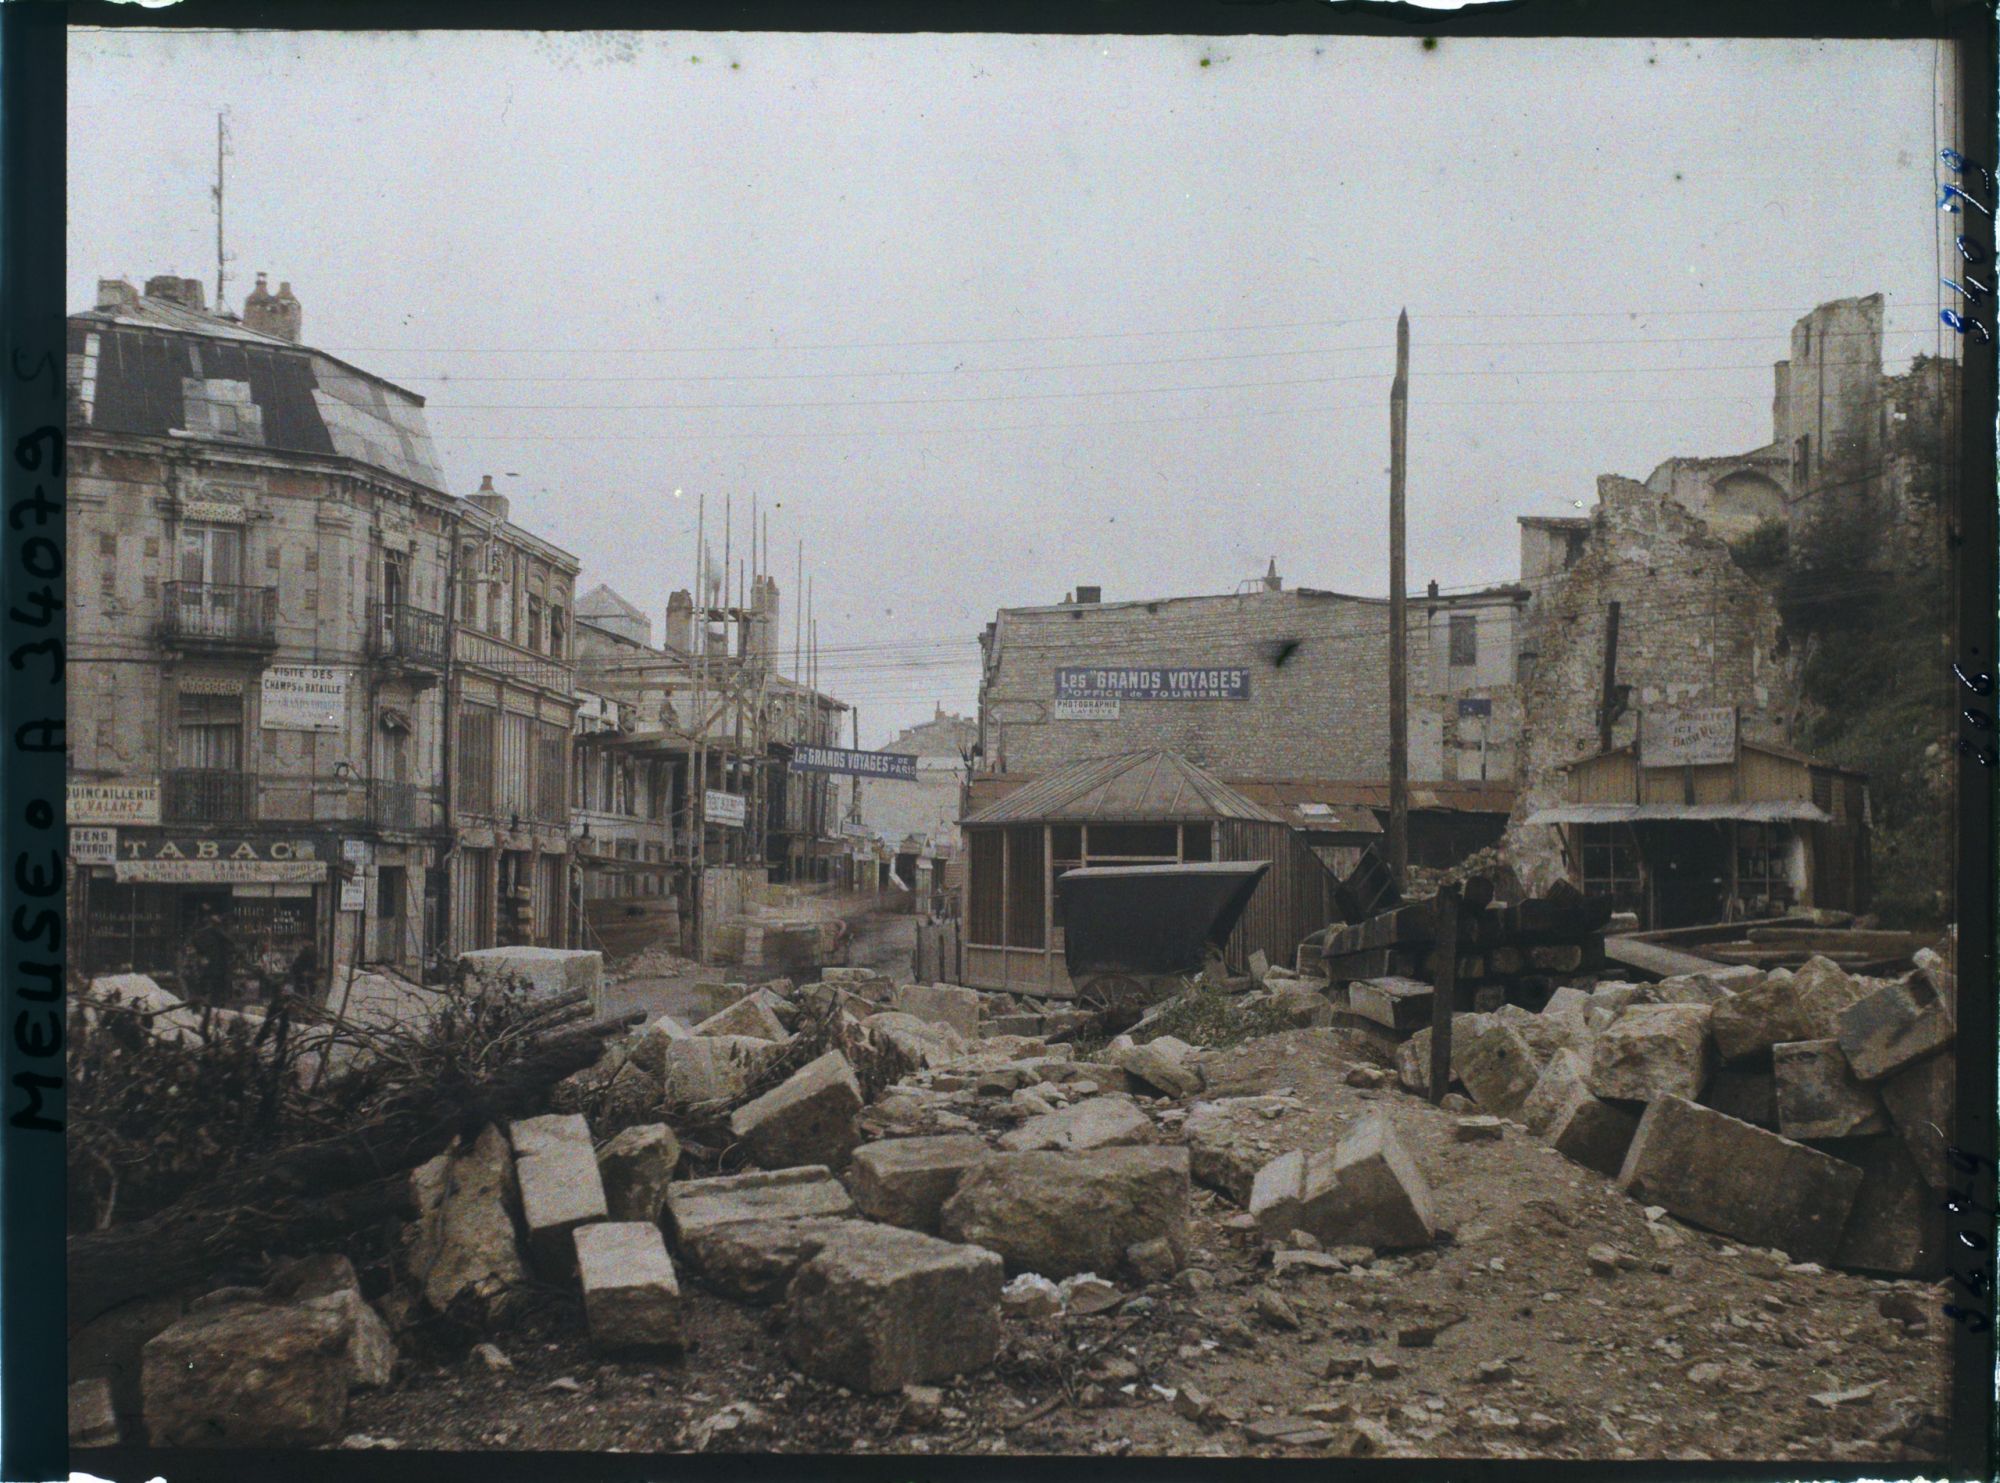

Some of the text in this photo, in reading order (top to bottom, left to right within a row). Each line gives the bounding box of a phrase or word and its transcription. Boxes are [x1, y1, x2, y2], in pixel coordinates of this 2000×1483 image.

[9, 425, 66, 685] 34079
[272, 667, 334, 680] VISITE DES
[1061, 671, 1087, 689] Les
[264, 679, 298, 692] CHAMPS
[304, 683, 342, 695] BATAILLE
[1150, 690, 1229, 699] TOURISME
[1056, 701, 1118, 709] PHOTOGRAPHIE
[14, 718, 67, 753] A
[897, 757, 909, 766] DE
[890, 763, 916, 775] PARIS
[74, 830, 108, 842] SENS
[71, 843, 112, 855] INTERDIT
[123, 839, 291, 860] TABAC
[9, 849, 65, 1134] MEUSE
